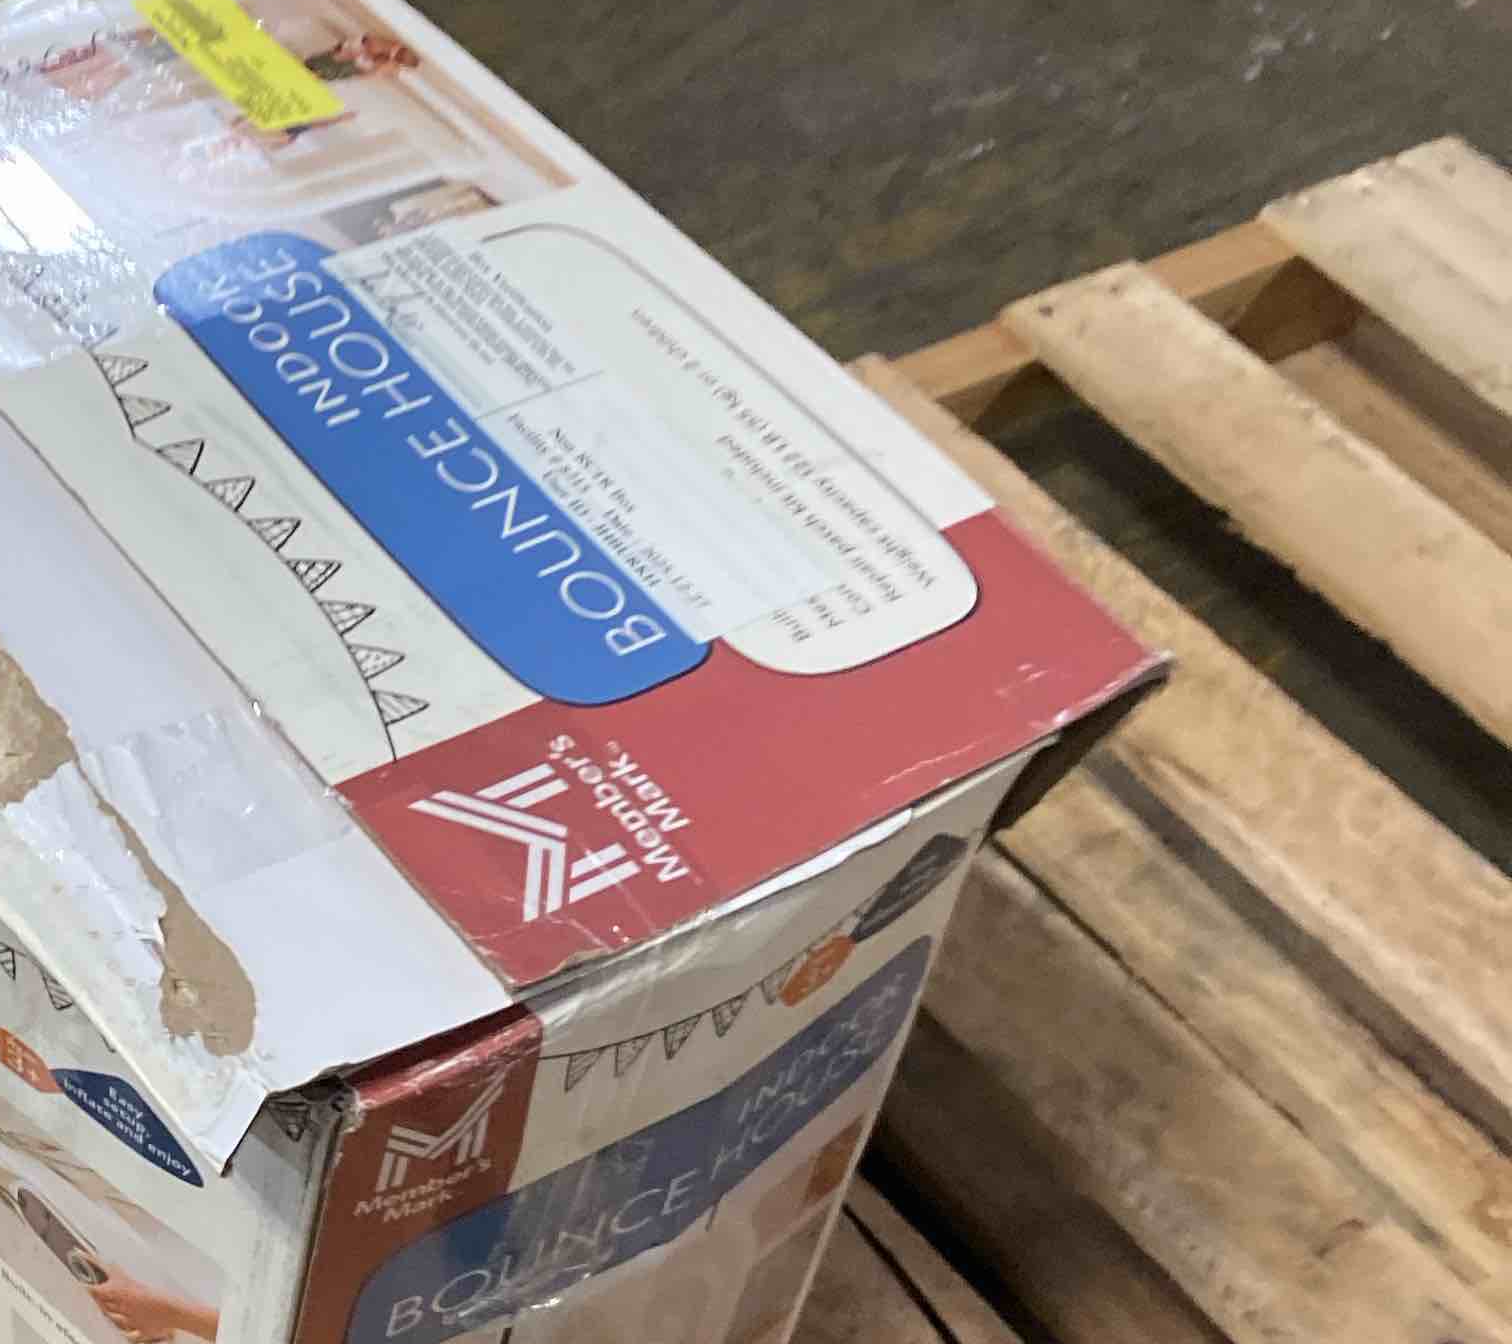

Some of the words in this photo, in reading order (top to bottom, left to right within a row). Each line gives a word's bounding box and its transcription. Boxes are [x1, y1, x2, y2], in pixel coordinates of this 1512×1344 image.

[196, 270, 361, 432] INDOOR
[241, 247, 416, 427] HOUSE
[405, 427, 670, 657] BOUNCE
[548, 731, 691, 886] Member's
[603, 751, 692, 834] Mark
[385, 1166, 700, 1339] BOUNCE
